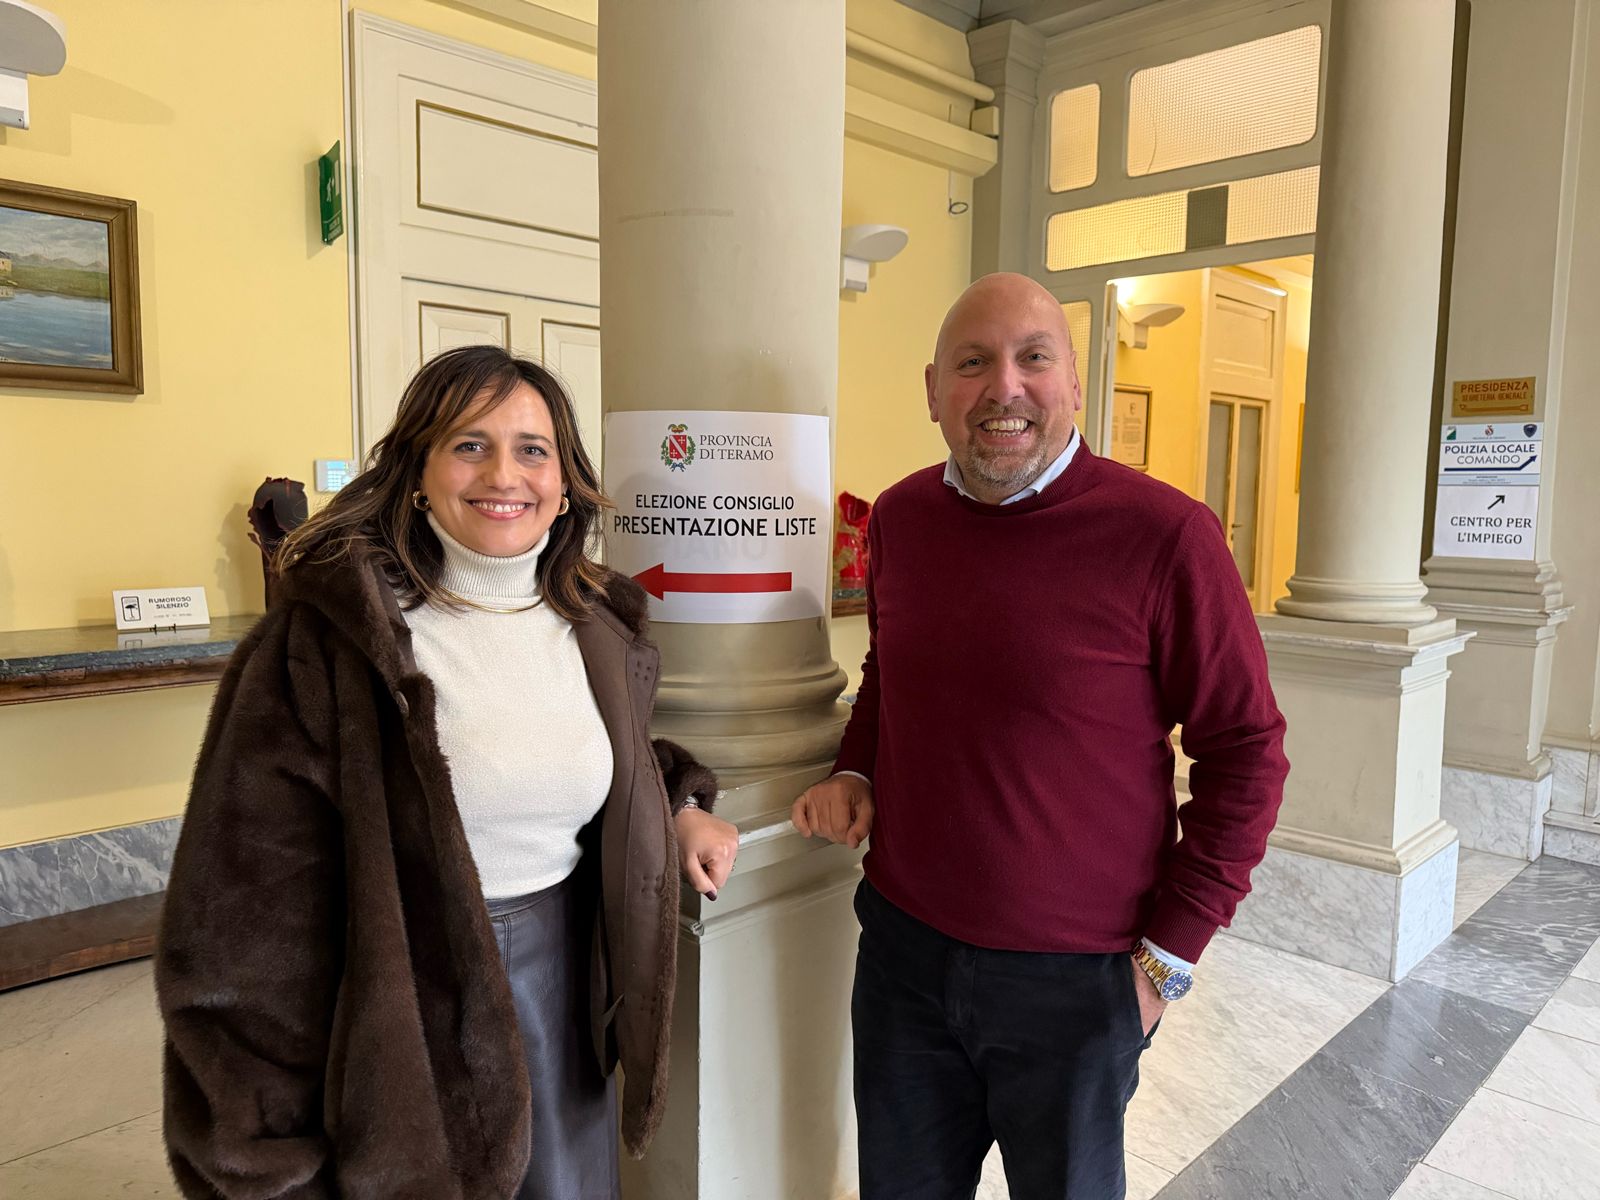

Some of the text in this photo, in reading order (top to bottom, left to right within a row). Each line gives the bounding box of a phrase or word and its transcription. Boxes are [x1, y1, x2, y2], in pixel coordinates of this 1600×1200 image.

[1461, 381, 1529, 393] PRESIDENZA
[700, 435, 772, 447] PROVINCIA
[700, 449, 773, 461] DI TERAMO
[1445, 444, 1535, 454] POLIZIA LOCALE
[1457, 454, 1520, 464] COMANDO
[636, 495, 794, 510] ELEZIONE CONSIGLIO
[614, 515, 816, 536] PRESENTAZIONE LISTE
[1451, 516, 1532, 528] CENTRO PER
[1457, 533, 1522, 544] L'IMPIEGO
